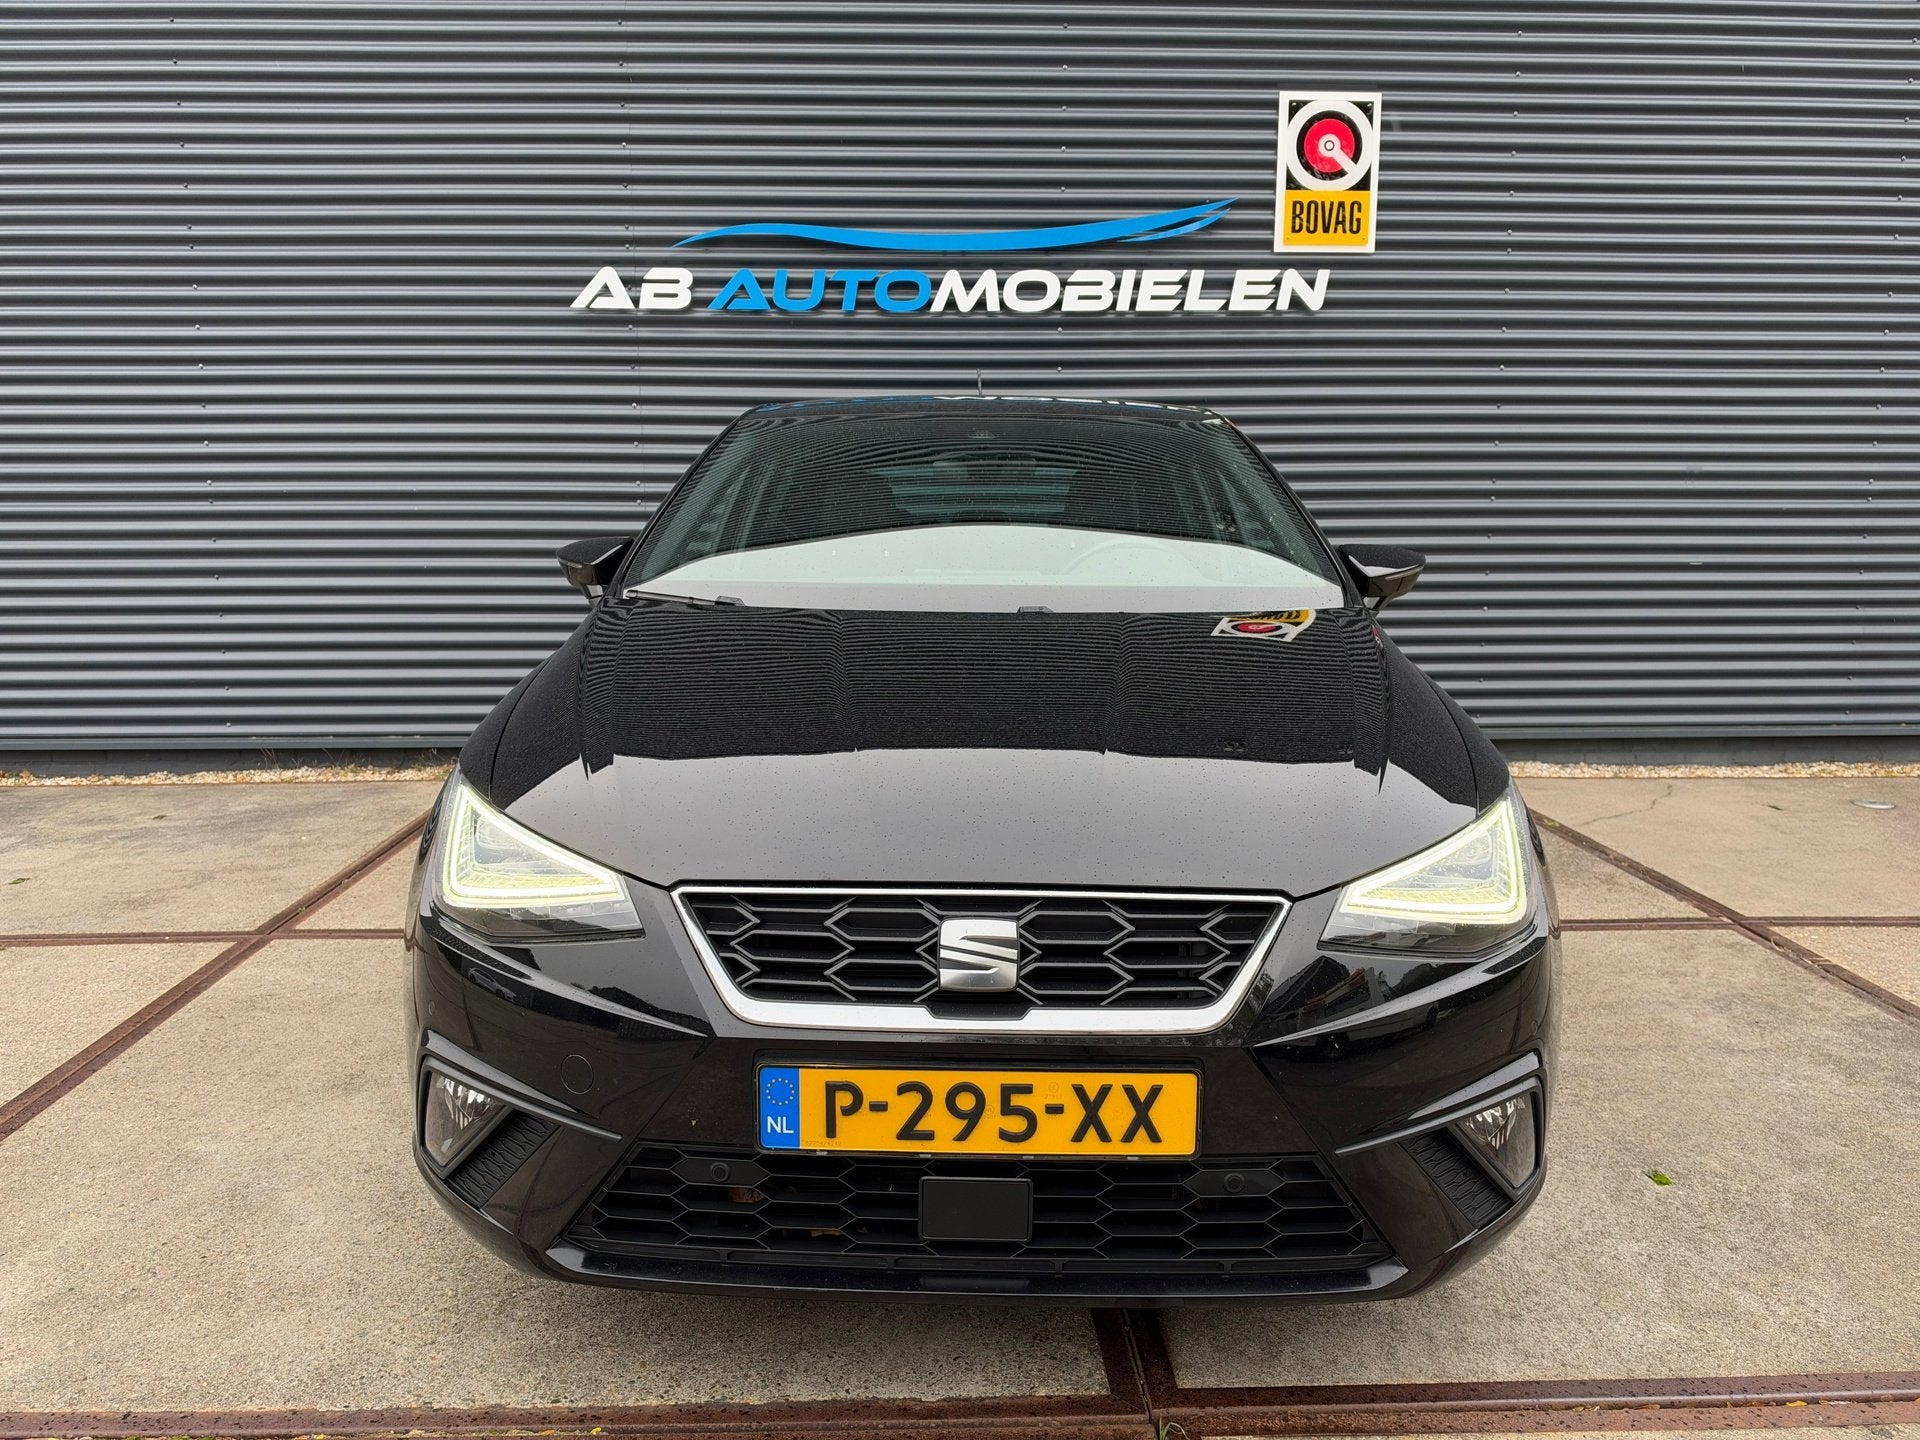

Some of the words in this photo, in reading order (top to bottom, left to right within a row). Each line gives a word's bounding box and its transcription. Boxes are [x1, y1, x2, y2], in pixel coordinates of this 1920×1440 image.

[1290, 199, 1362, 235] BOVAG
[569, 265, 696, 310] AB
[706, 267, 1331, 313] AUTOMOBIELEN
[766, 1115, 795, 1134] NL
[824, 1080, 1164, 1144] P-295-XX
